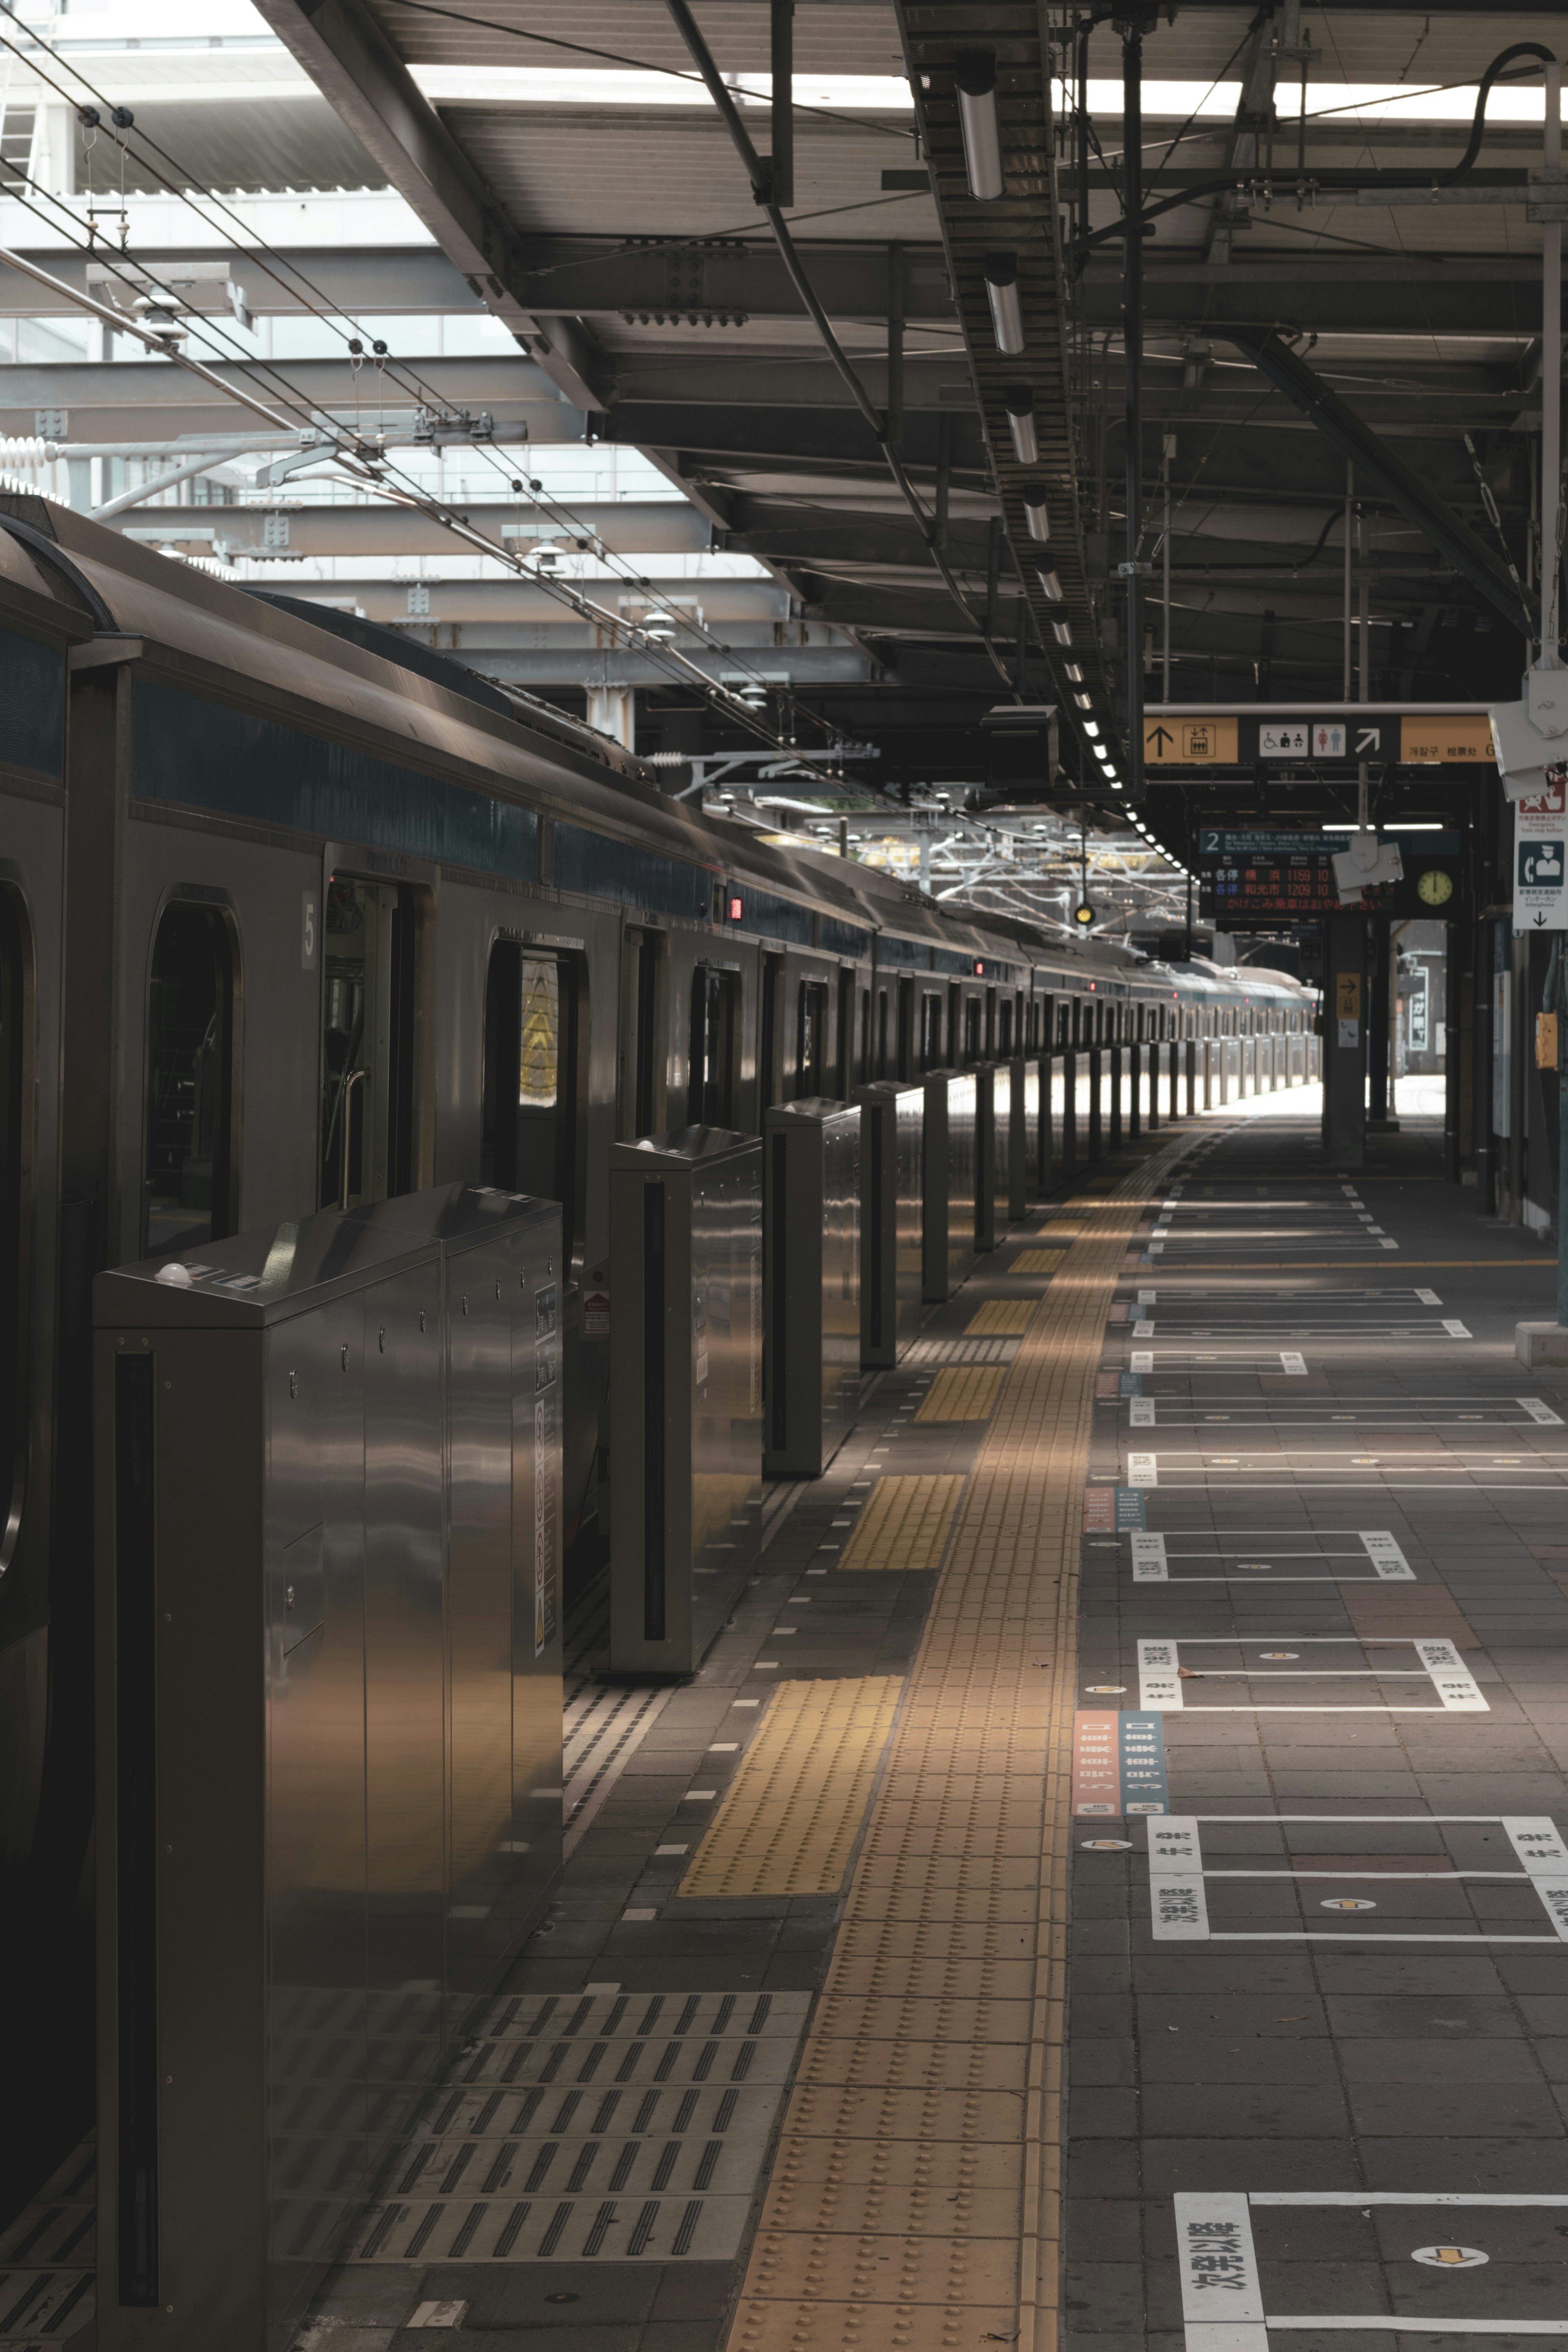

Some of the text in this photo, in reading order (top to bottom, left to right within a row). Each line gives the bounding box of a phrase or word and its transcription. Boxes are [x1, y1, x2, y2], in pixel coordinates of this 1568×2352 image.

[1409, 746, 1439, 756] 개찰구
[1447, 746, 1477, 757] 检票处
[1206, 833, 1219, 850] 2
[1216, 869, 1238, 881] 各停
[1318, 869, 1328, 882] 10
[1216, 884, 1238, 895] 各停
[1244, 884, 1280, 895] 和光市
[1318, 884, 1328, 895] 10
[305, 904, 313, 956] 5
[1143, 1647, 1172, 1666] 次発以降
[1421, 1646, 1458, 1666] 次発以降
[1145, 1683, 1176, 1699] 先発
[1441, 1683, 1477, 1699] 先発
[1079, 1724, 1115, 1789] 5号車乗車口
[1124, 1723, 1163, 1789] 3号車乗車口
[1155, 1832, 1193, 1855] 先発
[1515, 1833, 1563, 1858] 先発
[1158, 1888, 1200, 1923] 次発以降
[1187, 2223, 1247, 2290] 次発以降
